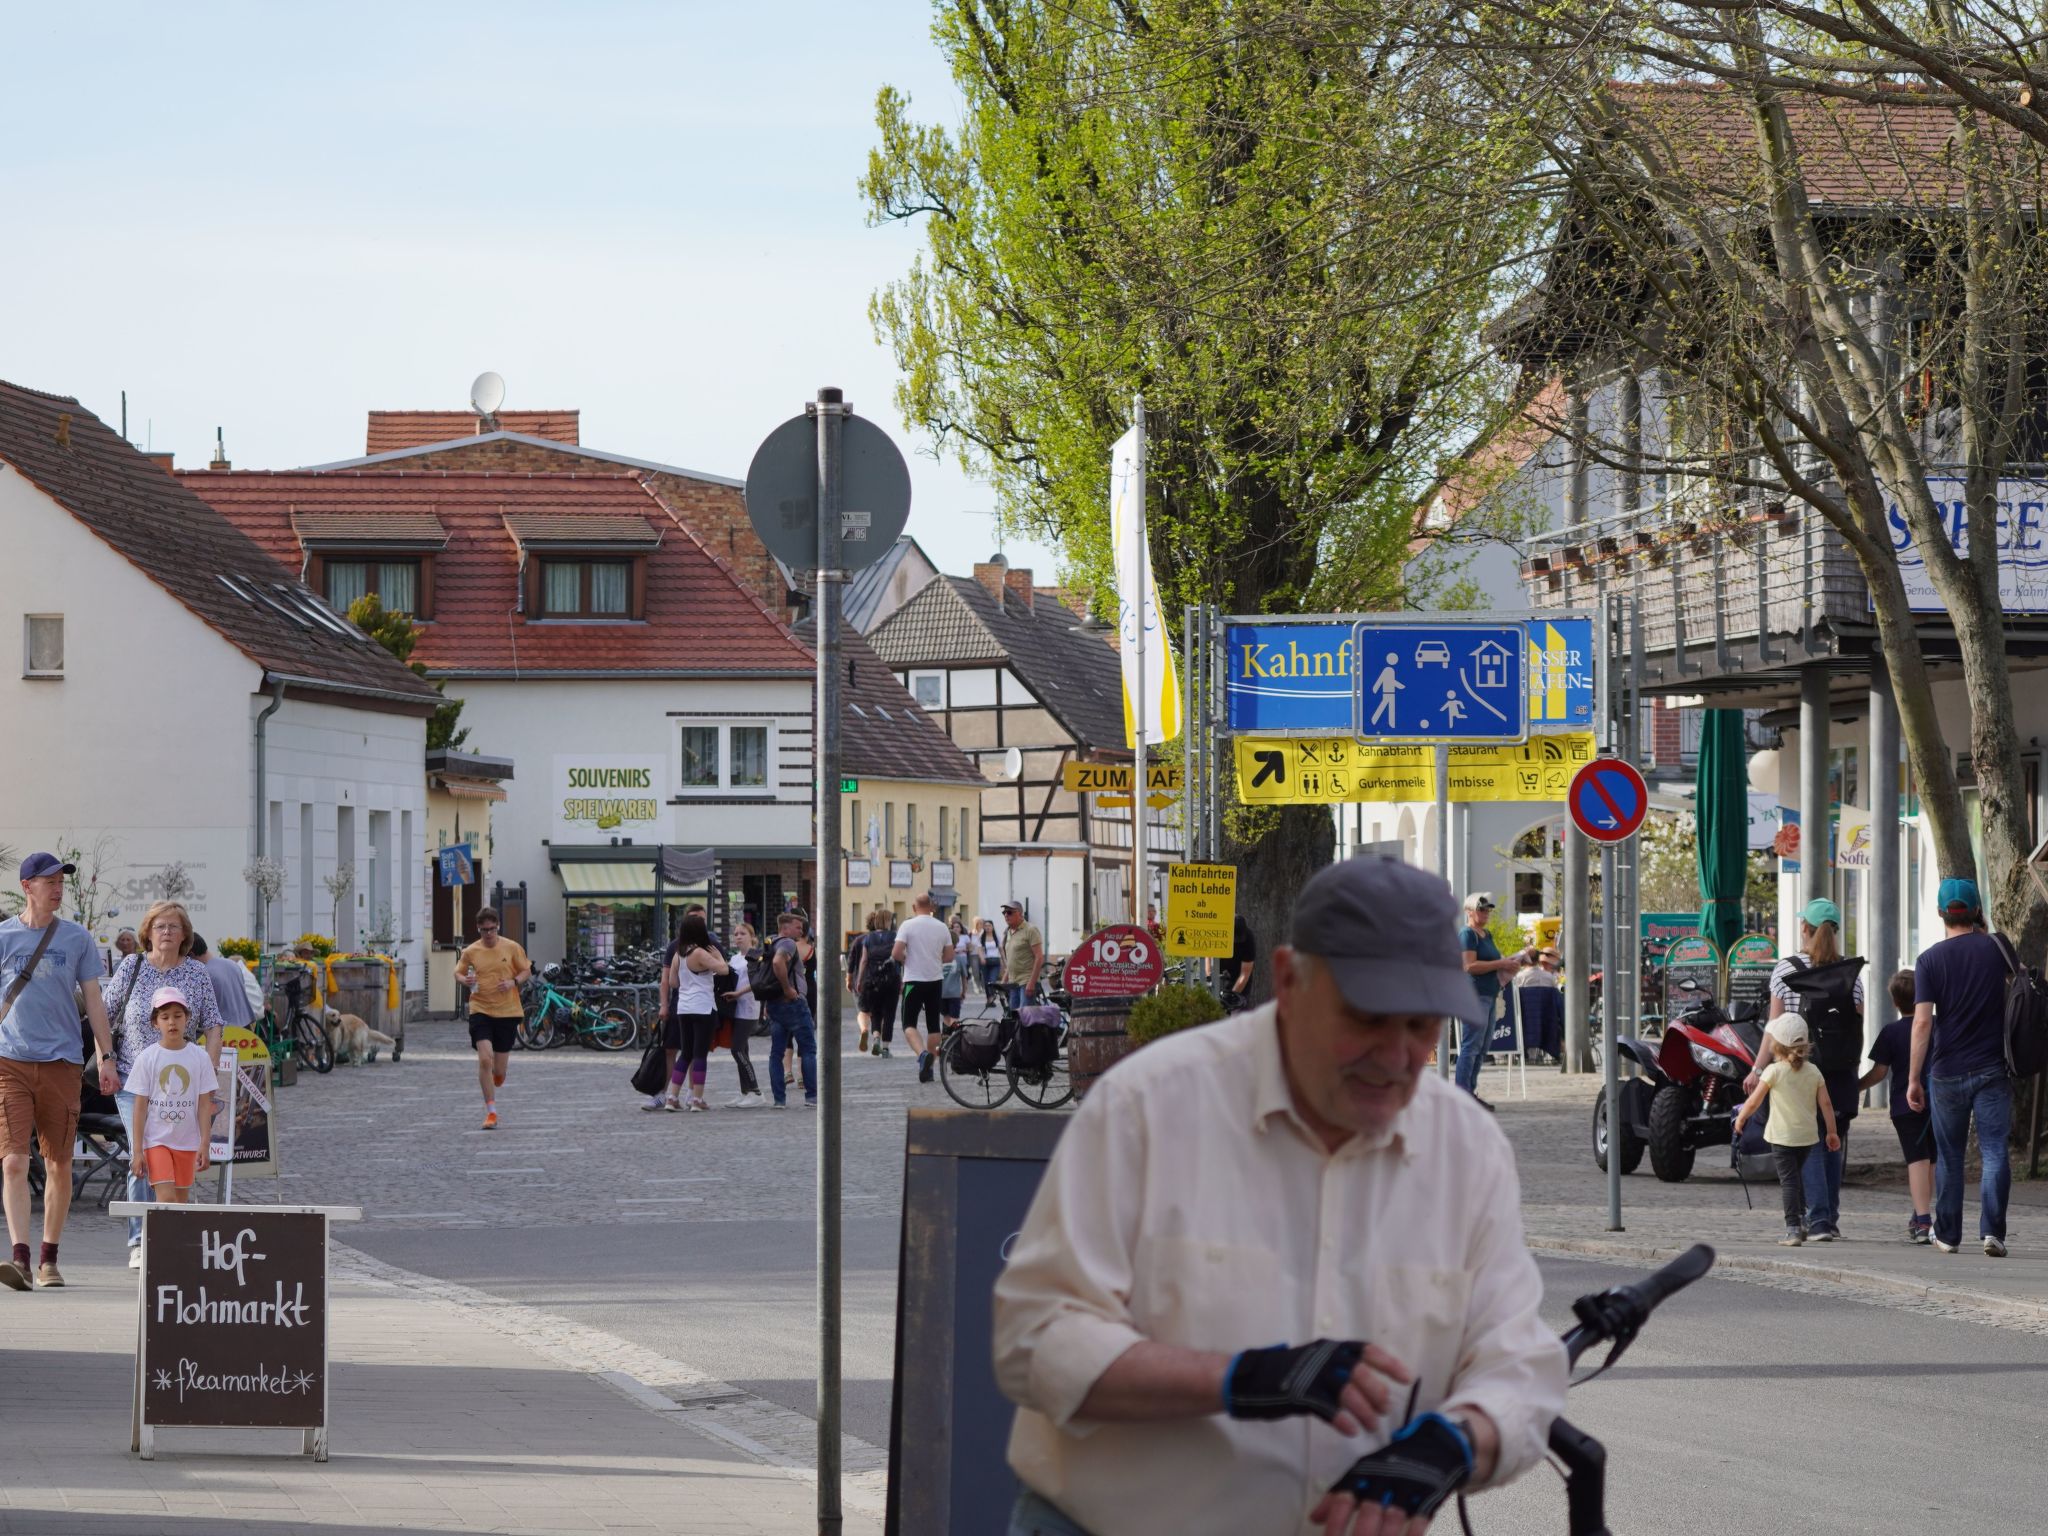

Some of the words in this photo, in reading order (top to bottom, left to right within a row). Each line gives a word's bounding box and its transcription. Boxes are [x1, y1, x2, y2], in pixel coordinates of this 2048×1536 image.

[1999, 586, 2010, 597] er
[2014, 584, 2048, 598] Kahnf
[1241, 639, 1360, 678] Kahnf
[1529, 650, 1582, 667] OSSER
[1447, 746, 1499, 757] estaurant
[568, 768, 651, 788] SOUVENIRS
[1078, 769, 1127, 788] ZUM
[1358, 776, 1426, 789] Gurkenmeile
[1449, 777, 1495, 788] Imbisse
[563, 798, 657, 820] SPIELWAREN
[1171, 865, 1235, 880] Kahnfahrten
[1173, 882, 1198, 894] nach
[1201, 883, 1231, 895] Lehde
[125, 904, 152, 912] HOTE
[1197, 900, 1207, 908] ab
[1185, 910, 1189, 918] 1
[1191, 910, 1218, 919] Stunde
[1185, 929, 1229, 938] GROSSER
[1192, 940, 1229, 949] HAFEN
[1071, 975, 1087, 983] 50
[219, 1061, 231, 1069] CH
[149, 1100, 174, 1108] PARIS
[210, 1147, 226, 1156] NG.
[234, 1149, 267, 1160] ATWURST
[202, 1228, 267, 1286] Hof-
[157, 1280, 312, 1328] Flohmarkt
